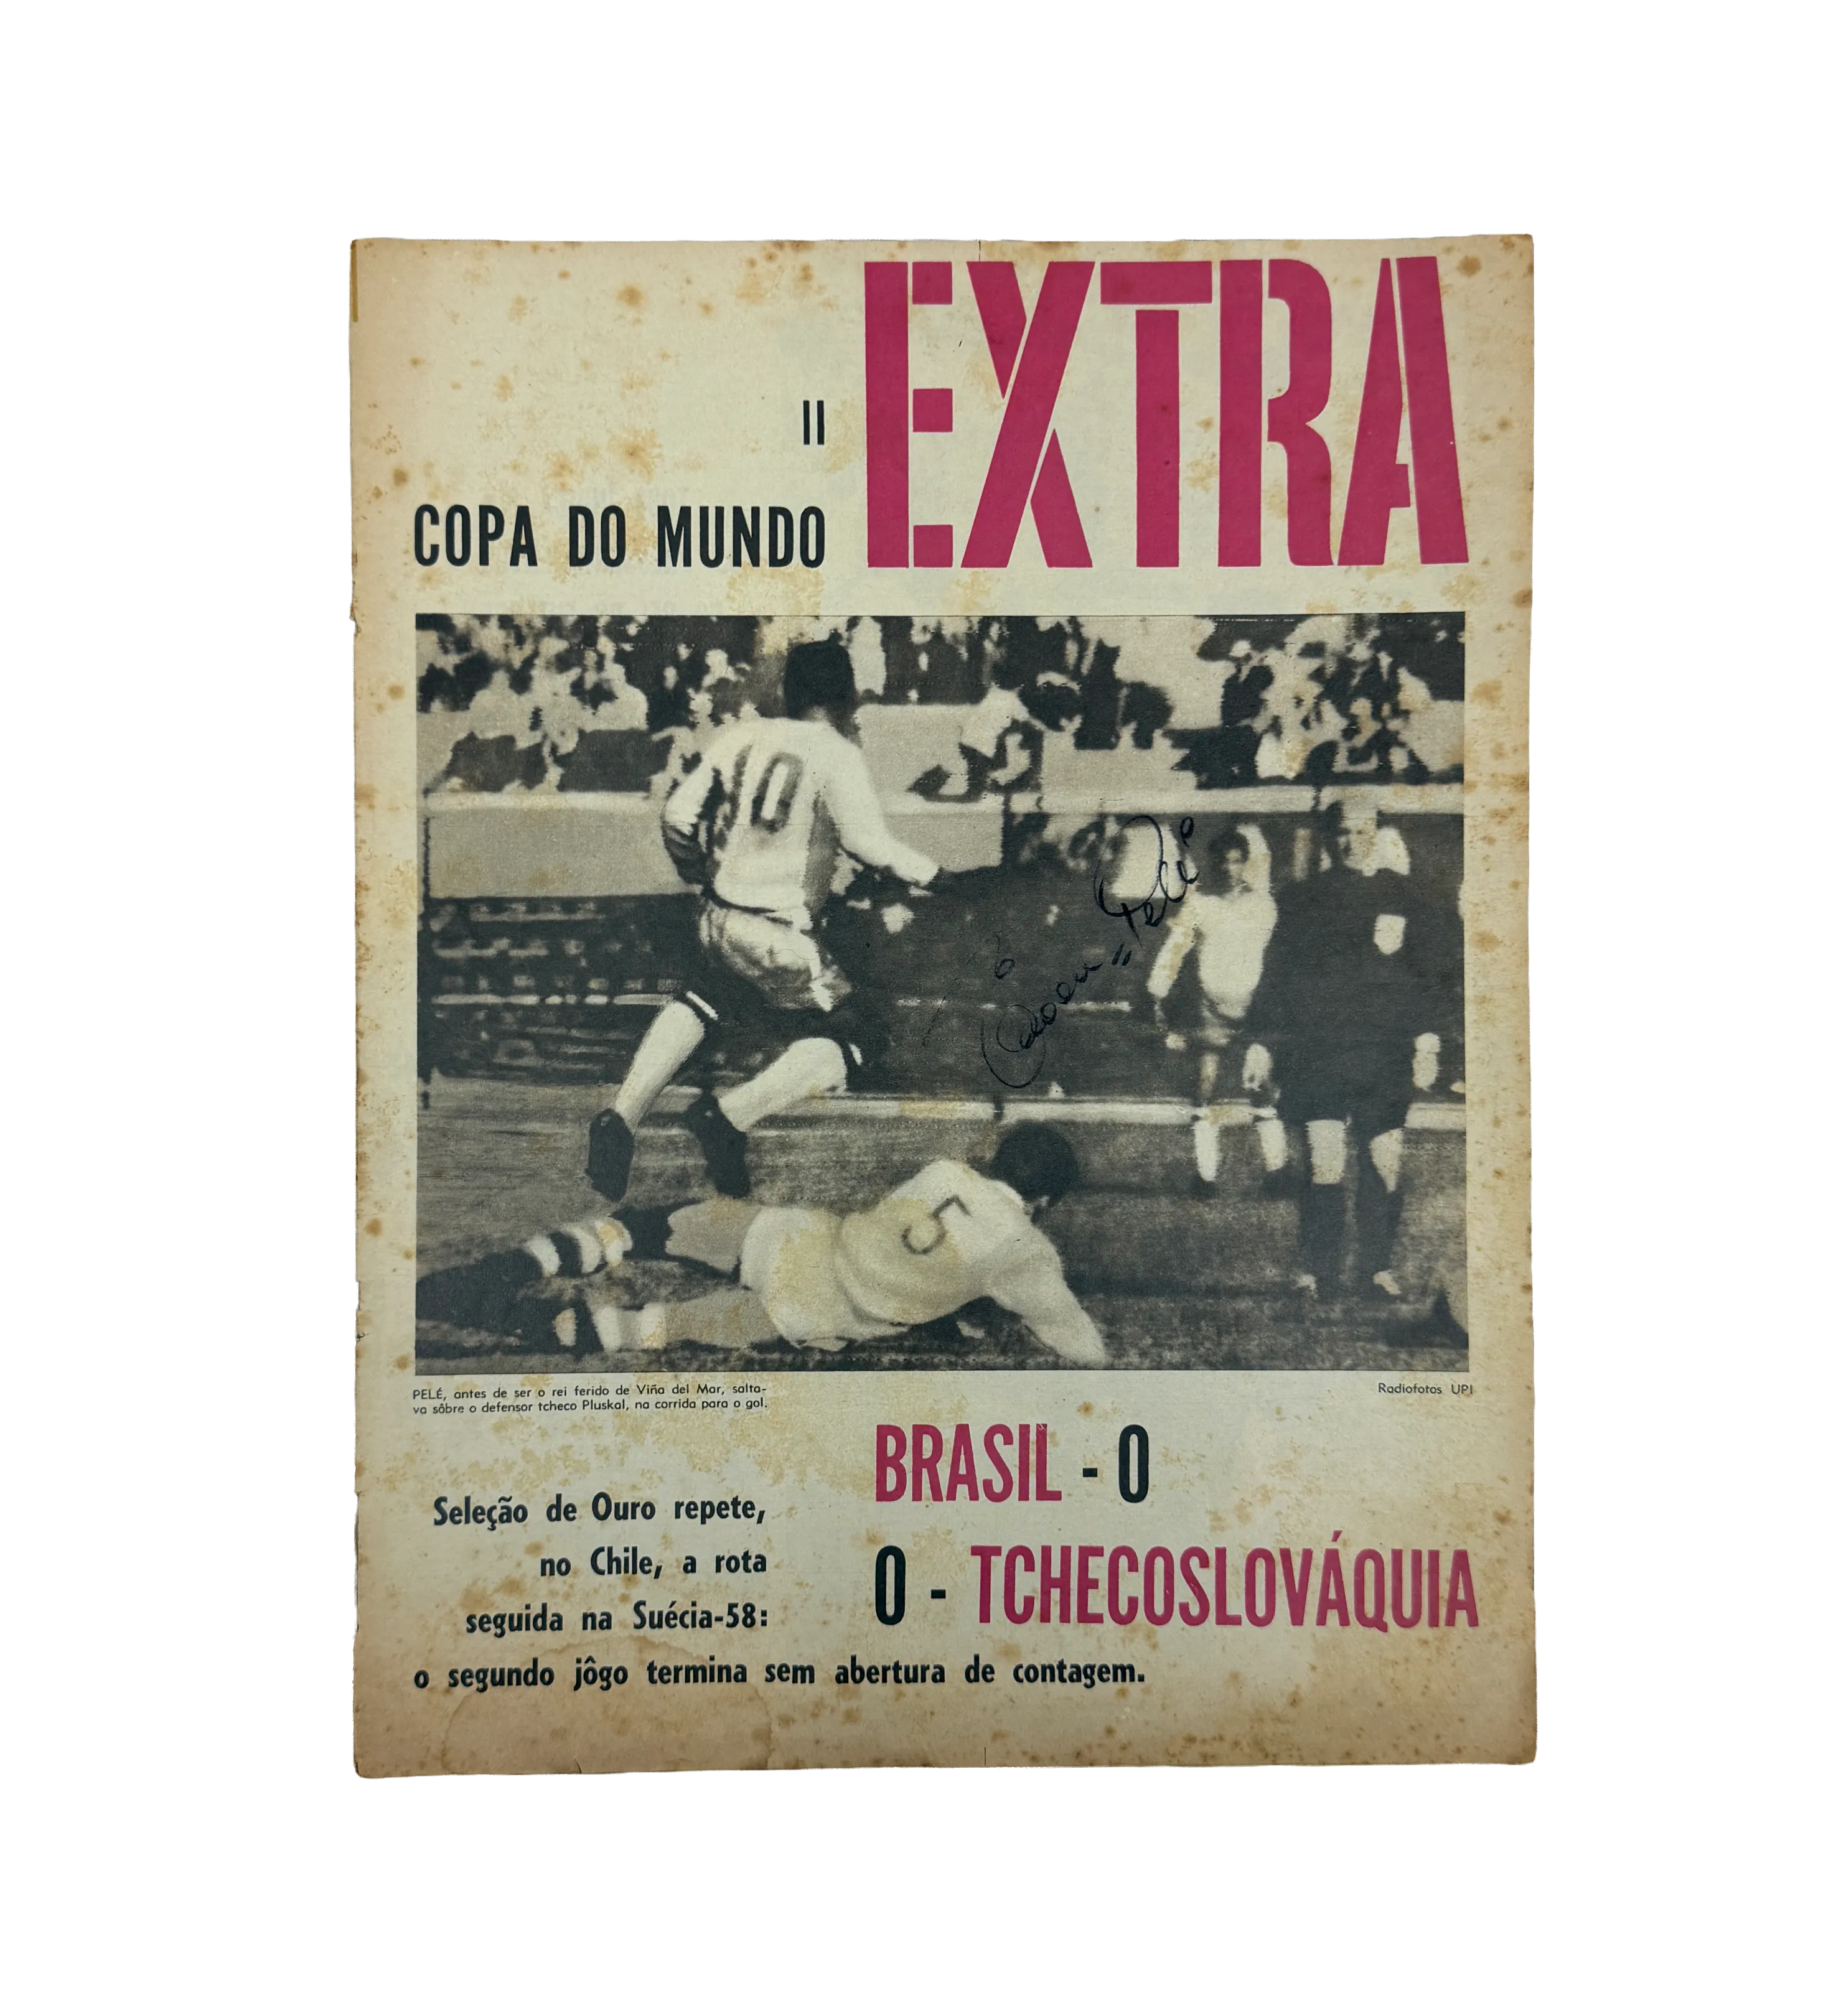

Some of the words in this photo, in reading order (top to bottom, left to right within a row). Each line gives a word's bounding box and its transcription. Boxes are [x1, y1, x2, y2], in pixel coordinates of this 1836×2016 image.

[803, 400, 825, 446] II
[864, 255, 1469, 569] EXTRA
[414, 504, 538, 567] COPA
[569, 505, 626, 567] DO
[657, 505, 825, 568] MUNDO
[722, 744, 803, 834] 10
[902, 1195, 973, 1255] 5
[413, 1388, 447, 1400] PELÉ,
[454, 1388, 487, 1399] antes
[493, 1387, 507, 1398] de
[514, 1389, 532, 1398] ser
[552, 1386, 567, 1396] rei
[574, 1385, 609, 1396] ferido
[616, 1384, 630, 1395] de
[636, 1384, 665, 1395] Viña
[672, 1383, 690, 1394] del
[696, 1383, 725, 1395] Mar,
[733, 1383, 767, 1394] salta-
[413, 1405, 427, 1414] va
[433, 1402, 464, 1413] sôbre
[469, 1405, 476, 1413] o
[482, 1401, 533, 1412] defensor
[538, 1401, 578, 1411] tcheco
[582, 1399, 629, 1411] Pluskal,
[635, 1401, 650, 1409] na
[655, 1399, 696, 1409] corrida
[701, 1400, 728, 1410] para
[734, 1399, 741, 1407] o
[746, 1397, 768, 1410] gol.
[1378, 1383, 1443, 1394] Radiofotos
[1451, 1384, 1473, 1394] UPI
[875, 1423, 1062, 1503] BRASIL
[1082, 1467, 1098, 1478] -
[1118, 1424, 1150, 1504] 0
[434, 1495, 528, 1531] Seleção
[546, 1493, 577, 1522] de
[591, 1491, 656, 1521] Ouro
[675, 1495, 766, 1525] repete,
[540, 1557, 571, 1577] no
[590, 1546, 663, 1579] Chile,
[682, 1555, 696, 1574] a
[715, 1549, 767, 1574] rota
[874, 1545, 906, 1626] 0
[930, 1589, 947, 1600] -
[970, 1530, 1479, 1633] TCHECOSLOVÁQUIA
[466, 1602, 563, 1638] seguida
[582, 1611, 612, 1631] na
[633, 1600, 767, 1630] Suécia-58:
[414, 1669, 430, 1689] o
[448, 1657, 555, 1693] segundo
[573, 1655, 629, 1692] jôgo
[646, 1654, 747, 1685] termina
[764, 1663, 815, 1684] sem
[835, 1654, 945, 1686] abertura
[964, 1653, 995, 1684] de
[1013, 1658, 1145, 1690] contagem.
